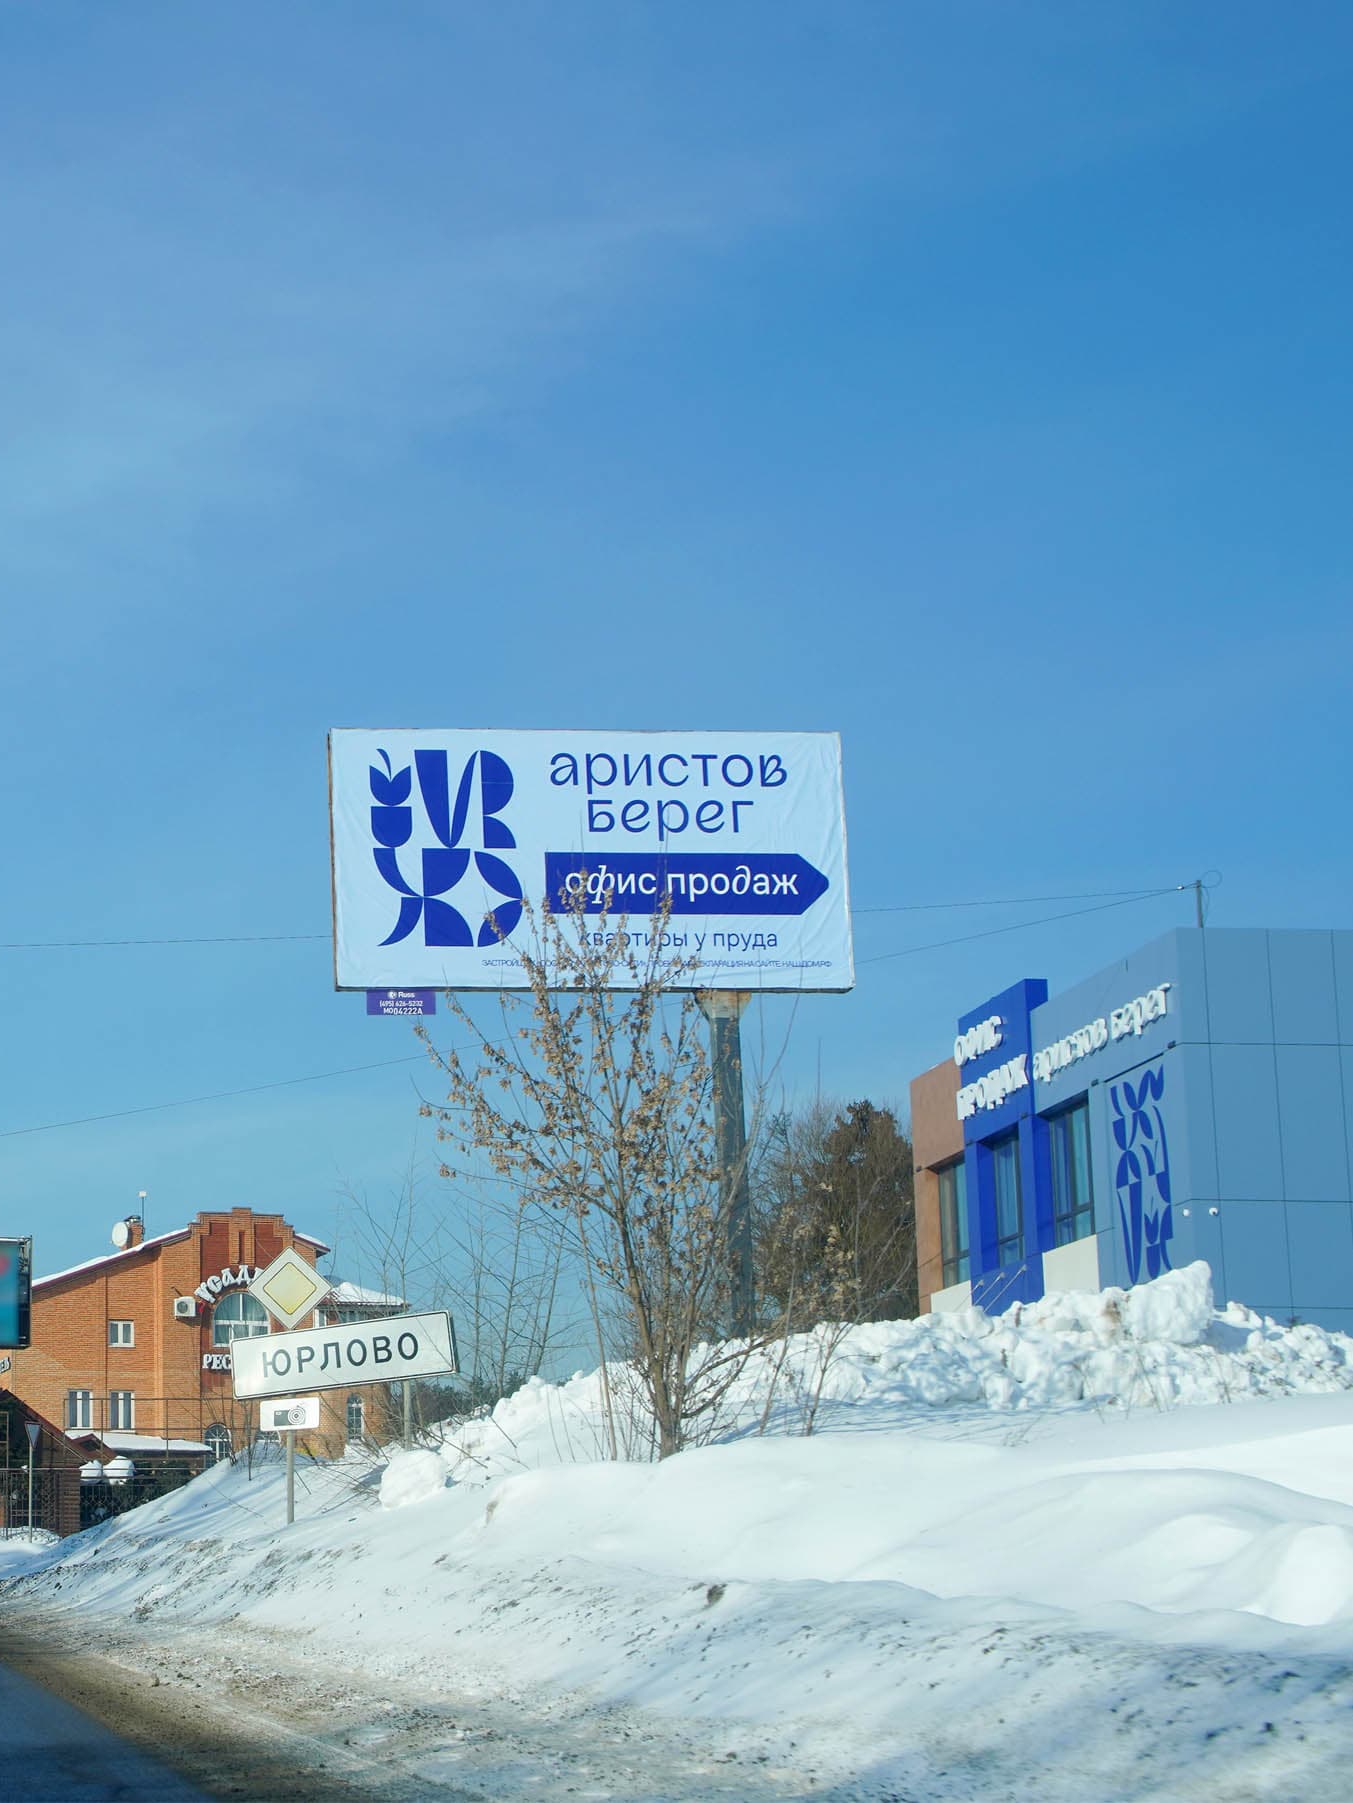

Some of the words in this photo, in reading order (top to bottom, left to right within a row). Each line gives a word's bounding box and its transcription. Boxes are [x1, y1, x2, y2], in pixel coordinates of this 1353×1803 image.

[550, 752, 788, 795] аристов
[565, 864, 657, 904] офис
[666, 865, 799, 902] продаж
[695, 933, 707, 952] у
[713, 932, 778, 952] пруда
[262, 1332, 419, 1378] ЮРЛОВО
